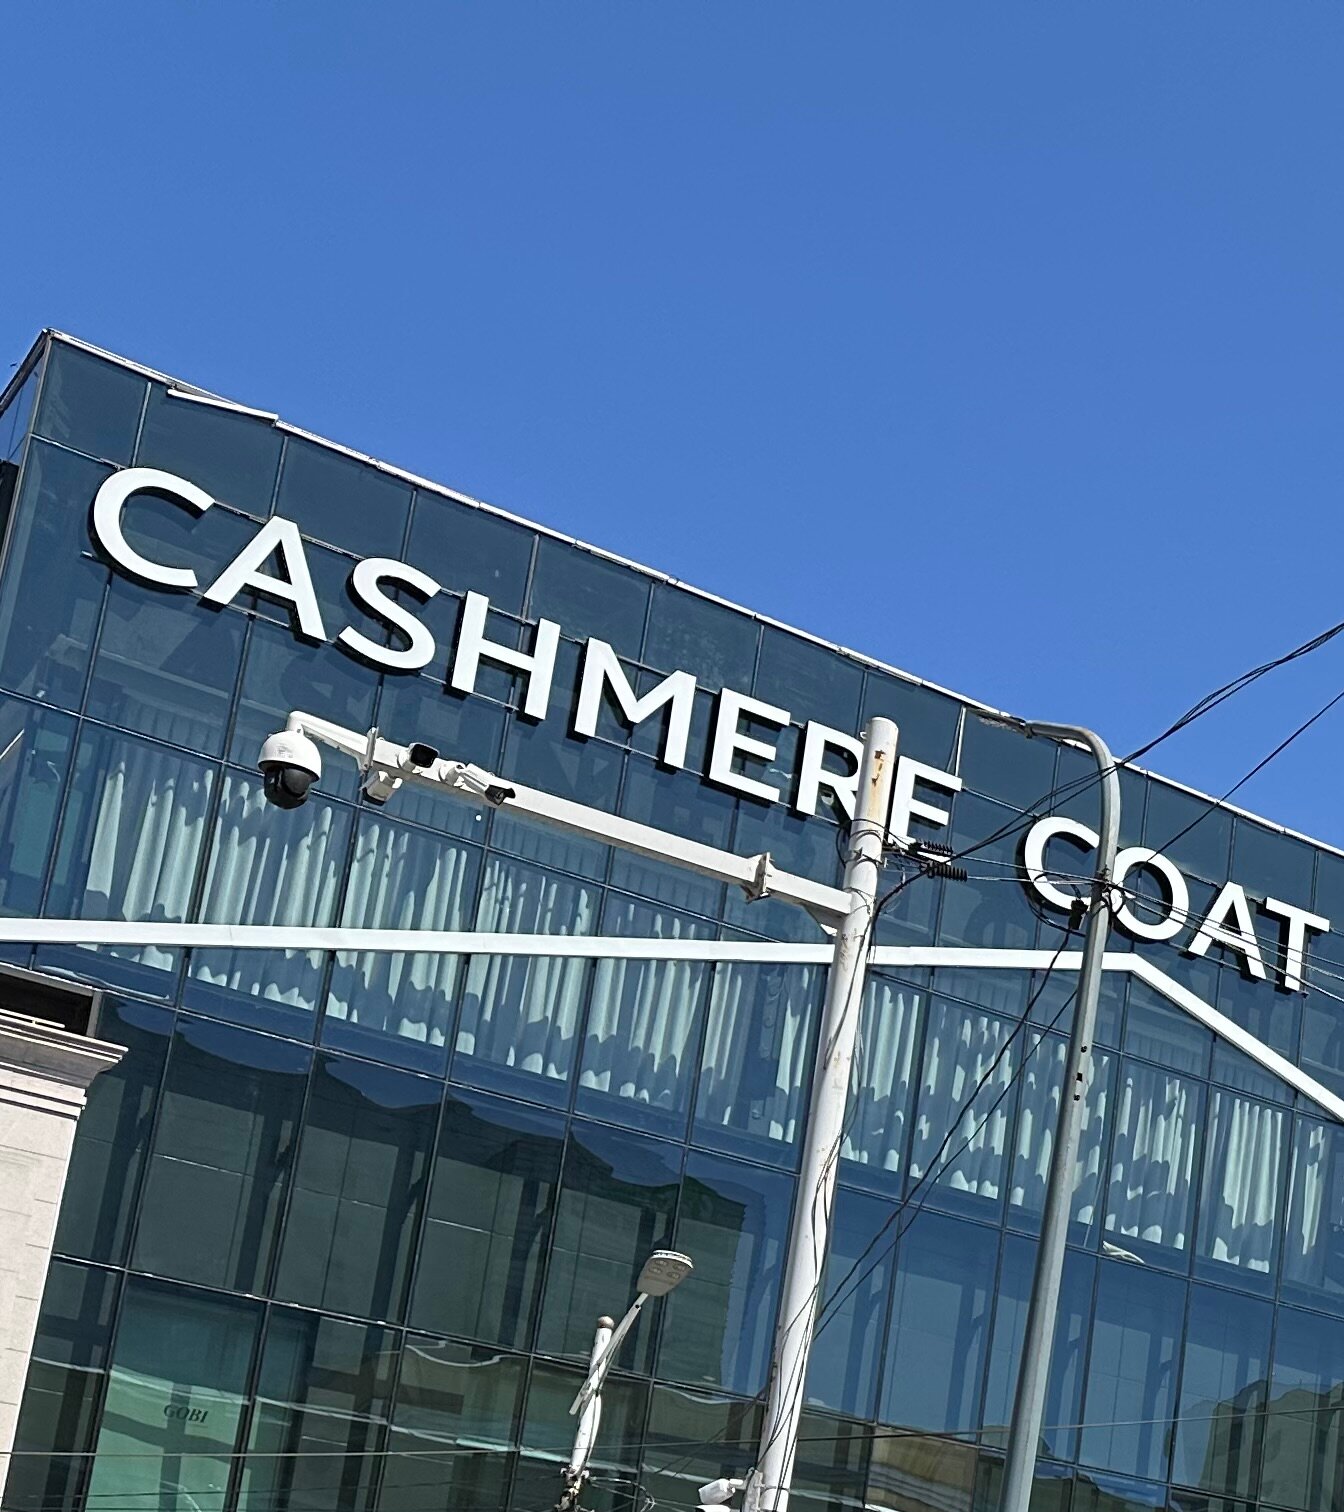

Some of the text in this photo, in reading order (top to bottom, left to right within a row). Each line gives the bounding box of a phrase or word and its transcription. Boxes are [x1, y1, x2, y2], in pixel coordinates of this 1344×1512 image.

[92, 466, 963, 850] CASHMERE
[1018, 815, 1330, 993] COAT
[164, 1404, 208, 1423] GOBI
